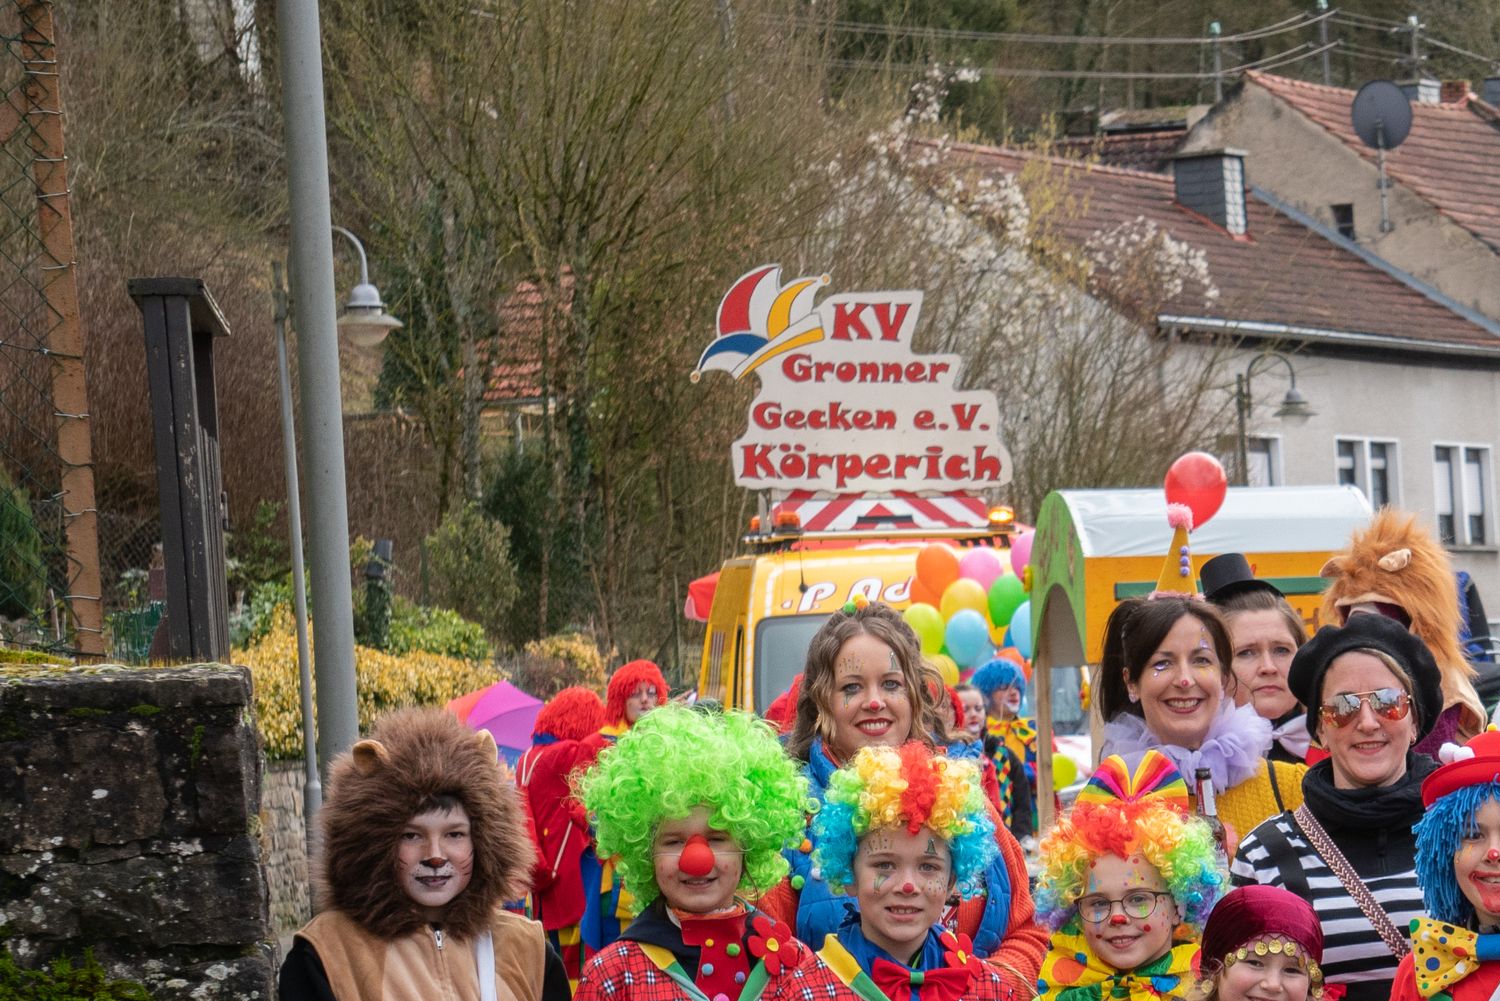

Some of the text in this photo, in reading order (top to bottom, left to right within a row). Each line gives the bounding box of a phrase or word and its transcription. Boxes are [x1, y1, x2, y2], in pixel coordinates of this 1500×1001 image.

[830, 301, 913, 342] KV
[782, 353, 950, 383] Gronner
[752, 401, 990, 431] Gecken e.V.
[739, 443, 1002, 489] Körperich
